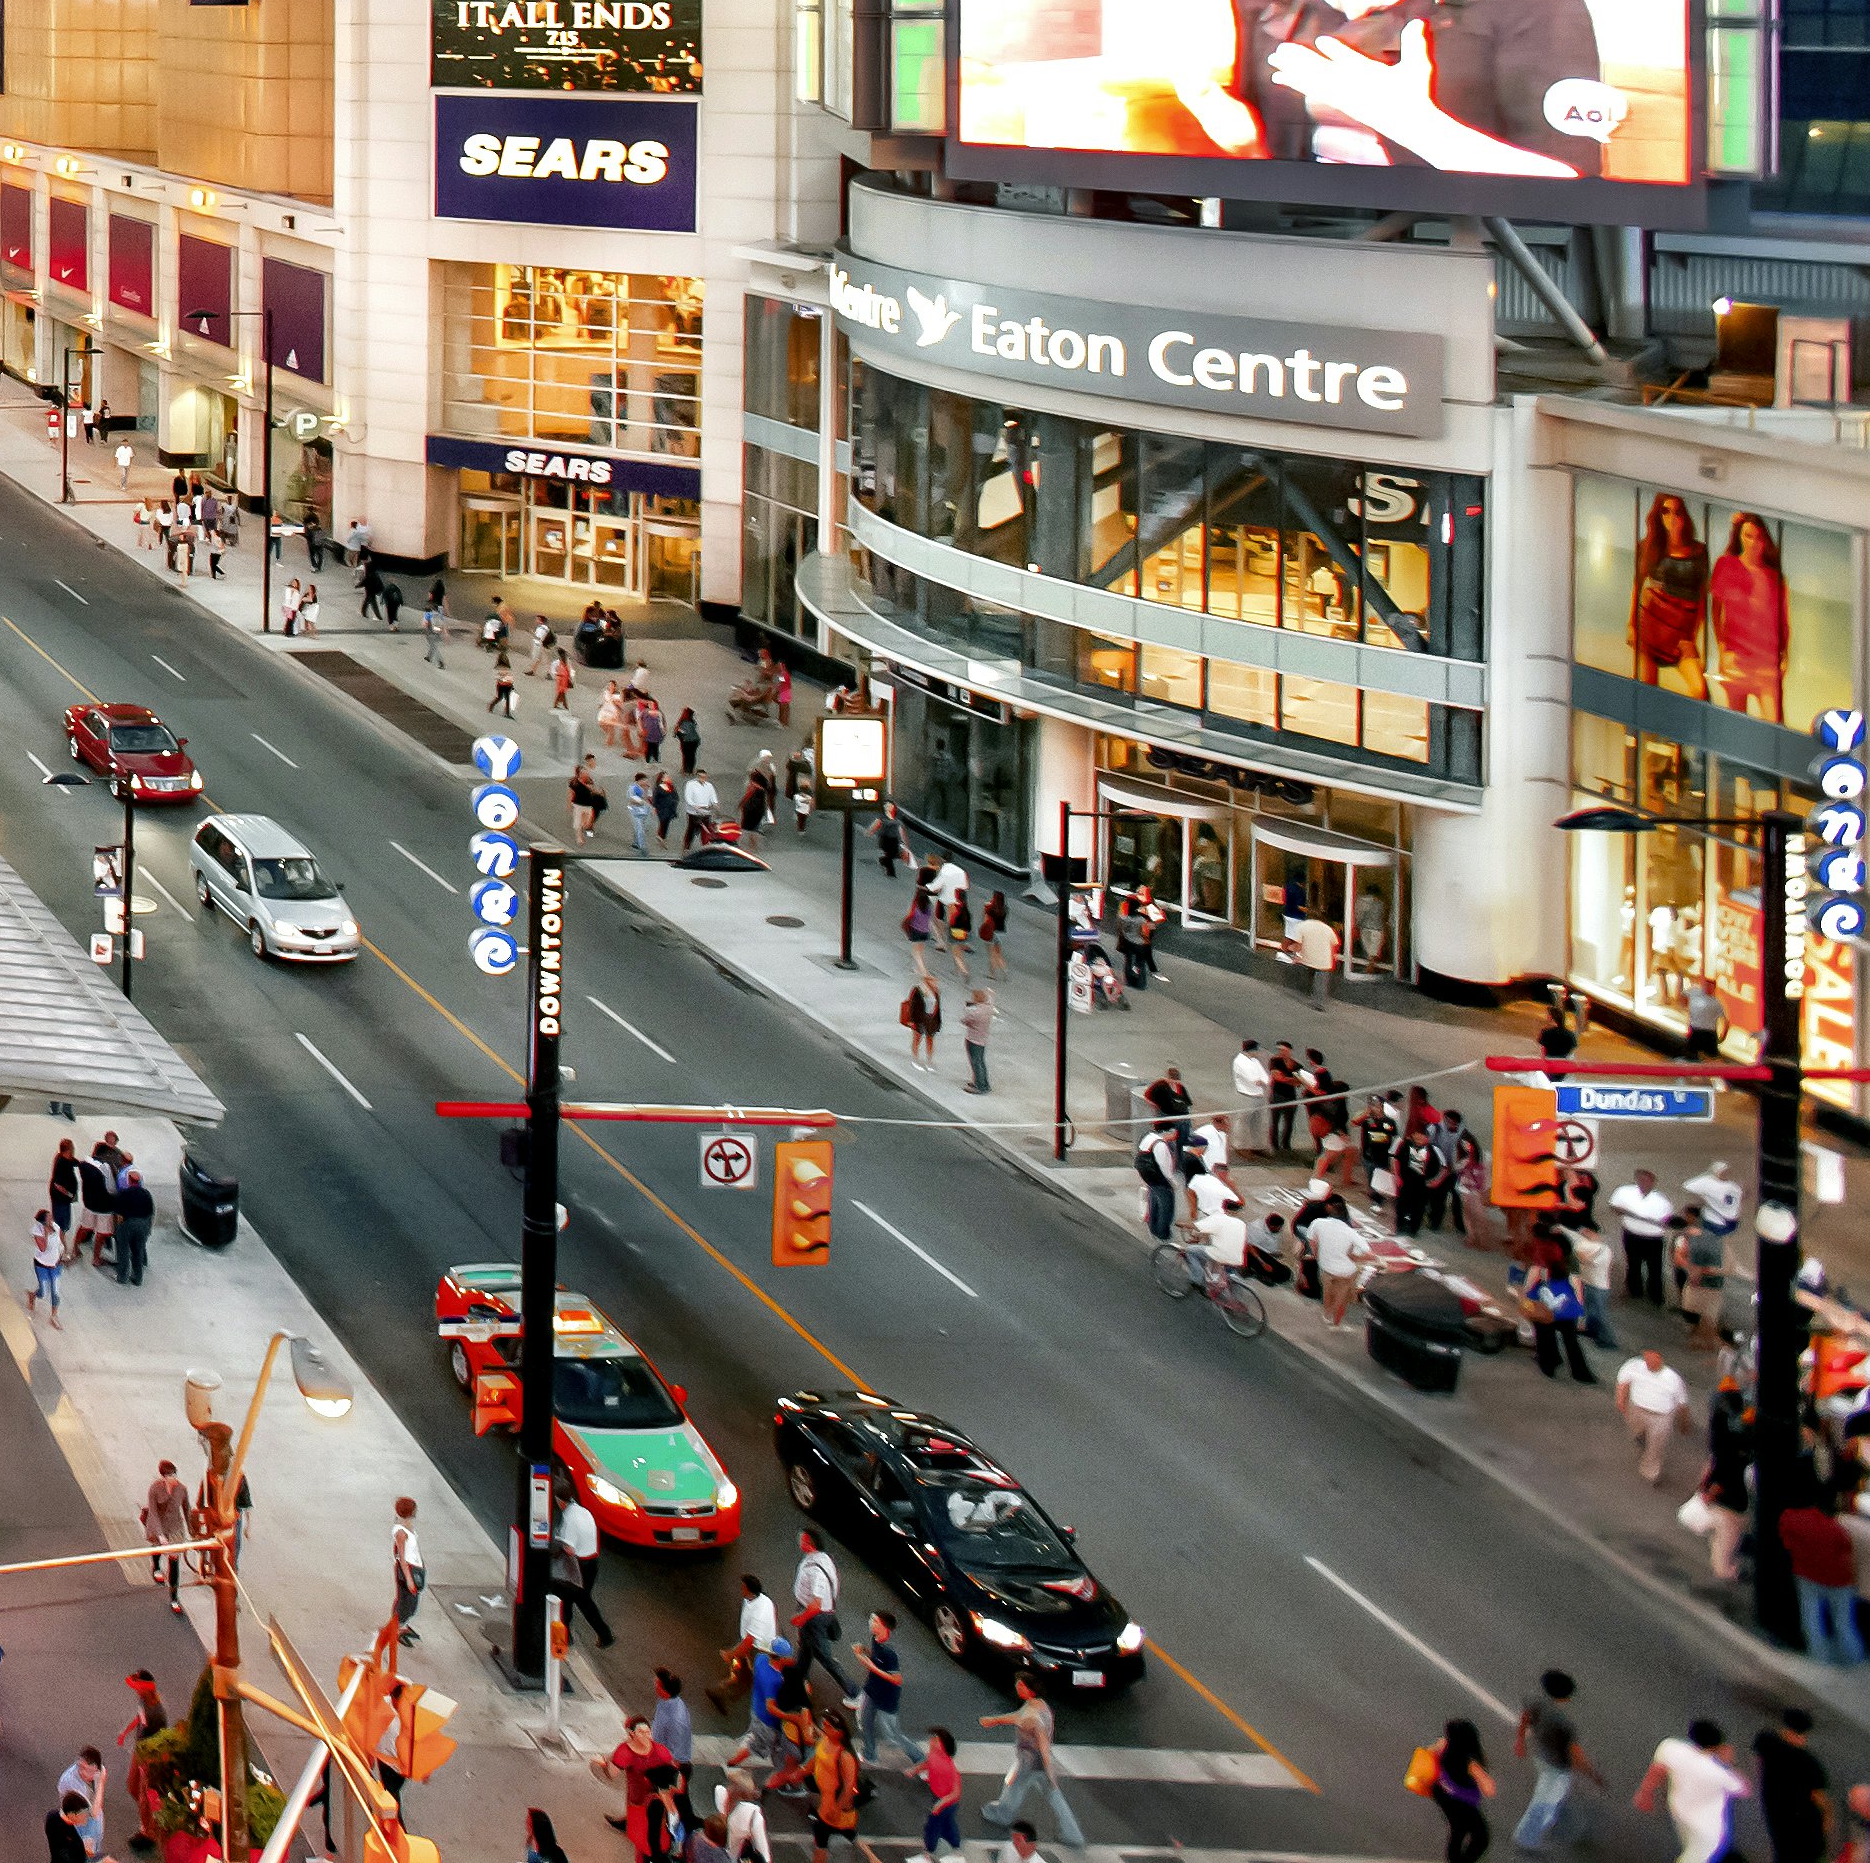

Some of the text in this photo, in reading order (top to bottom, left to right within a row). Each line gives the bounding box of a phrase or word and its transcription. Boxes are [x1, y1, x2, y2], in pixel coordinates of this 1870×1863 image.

[456, 2, 673, 30] IT ALL ENDS
[459, 133, 670, 185] SEARS
[971, 304, 1410, 411] Eaton Centre
[296, 413, 318, 439] P
[504, 450, 614, 484] SEARS
[1819, 710, 1866, 940] Yonge
[469, 737, 520, 976] Yonge
[538, 868, 564, 1037] DOWNTOWN
[1580, 1087, 1666, 1112] Dundas
